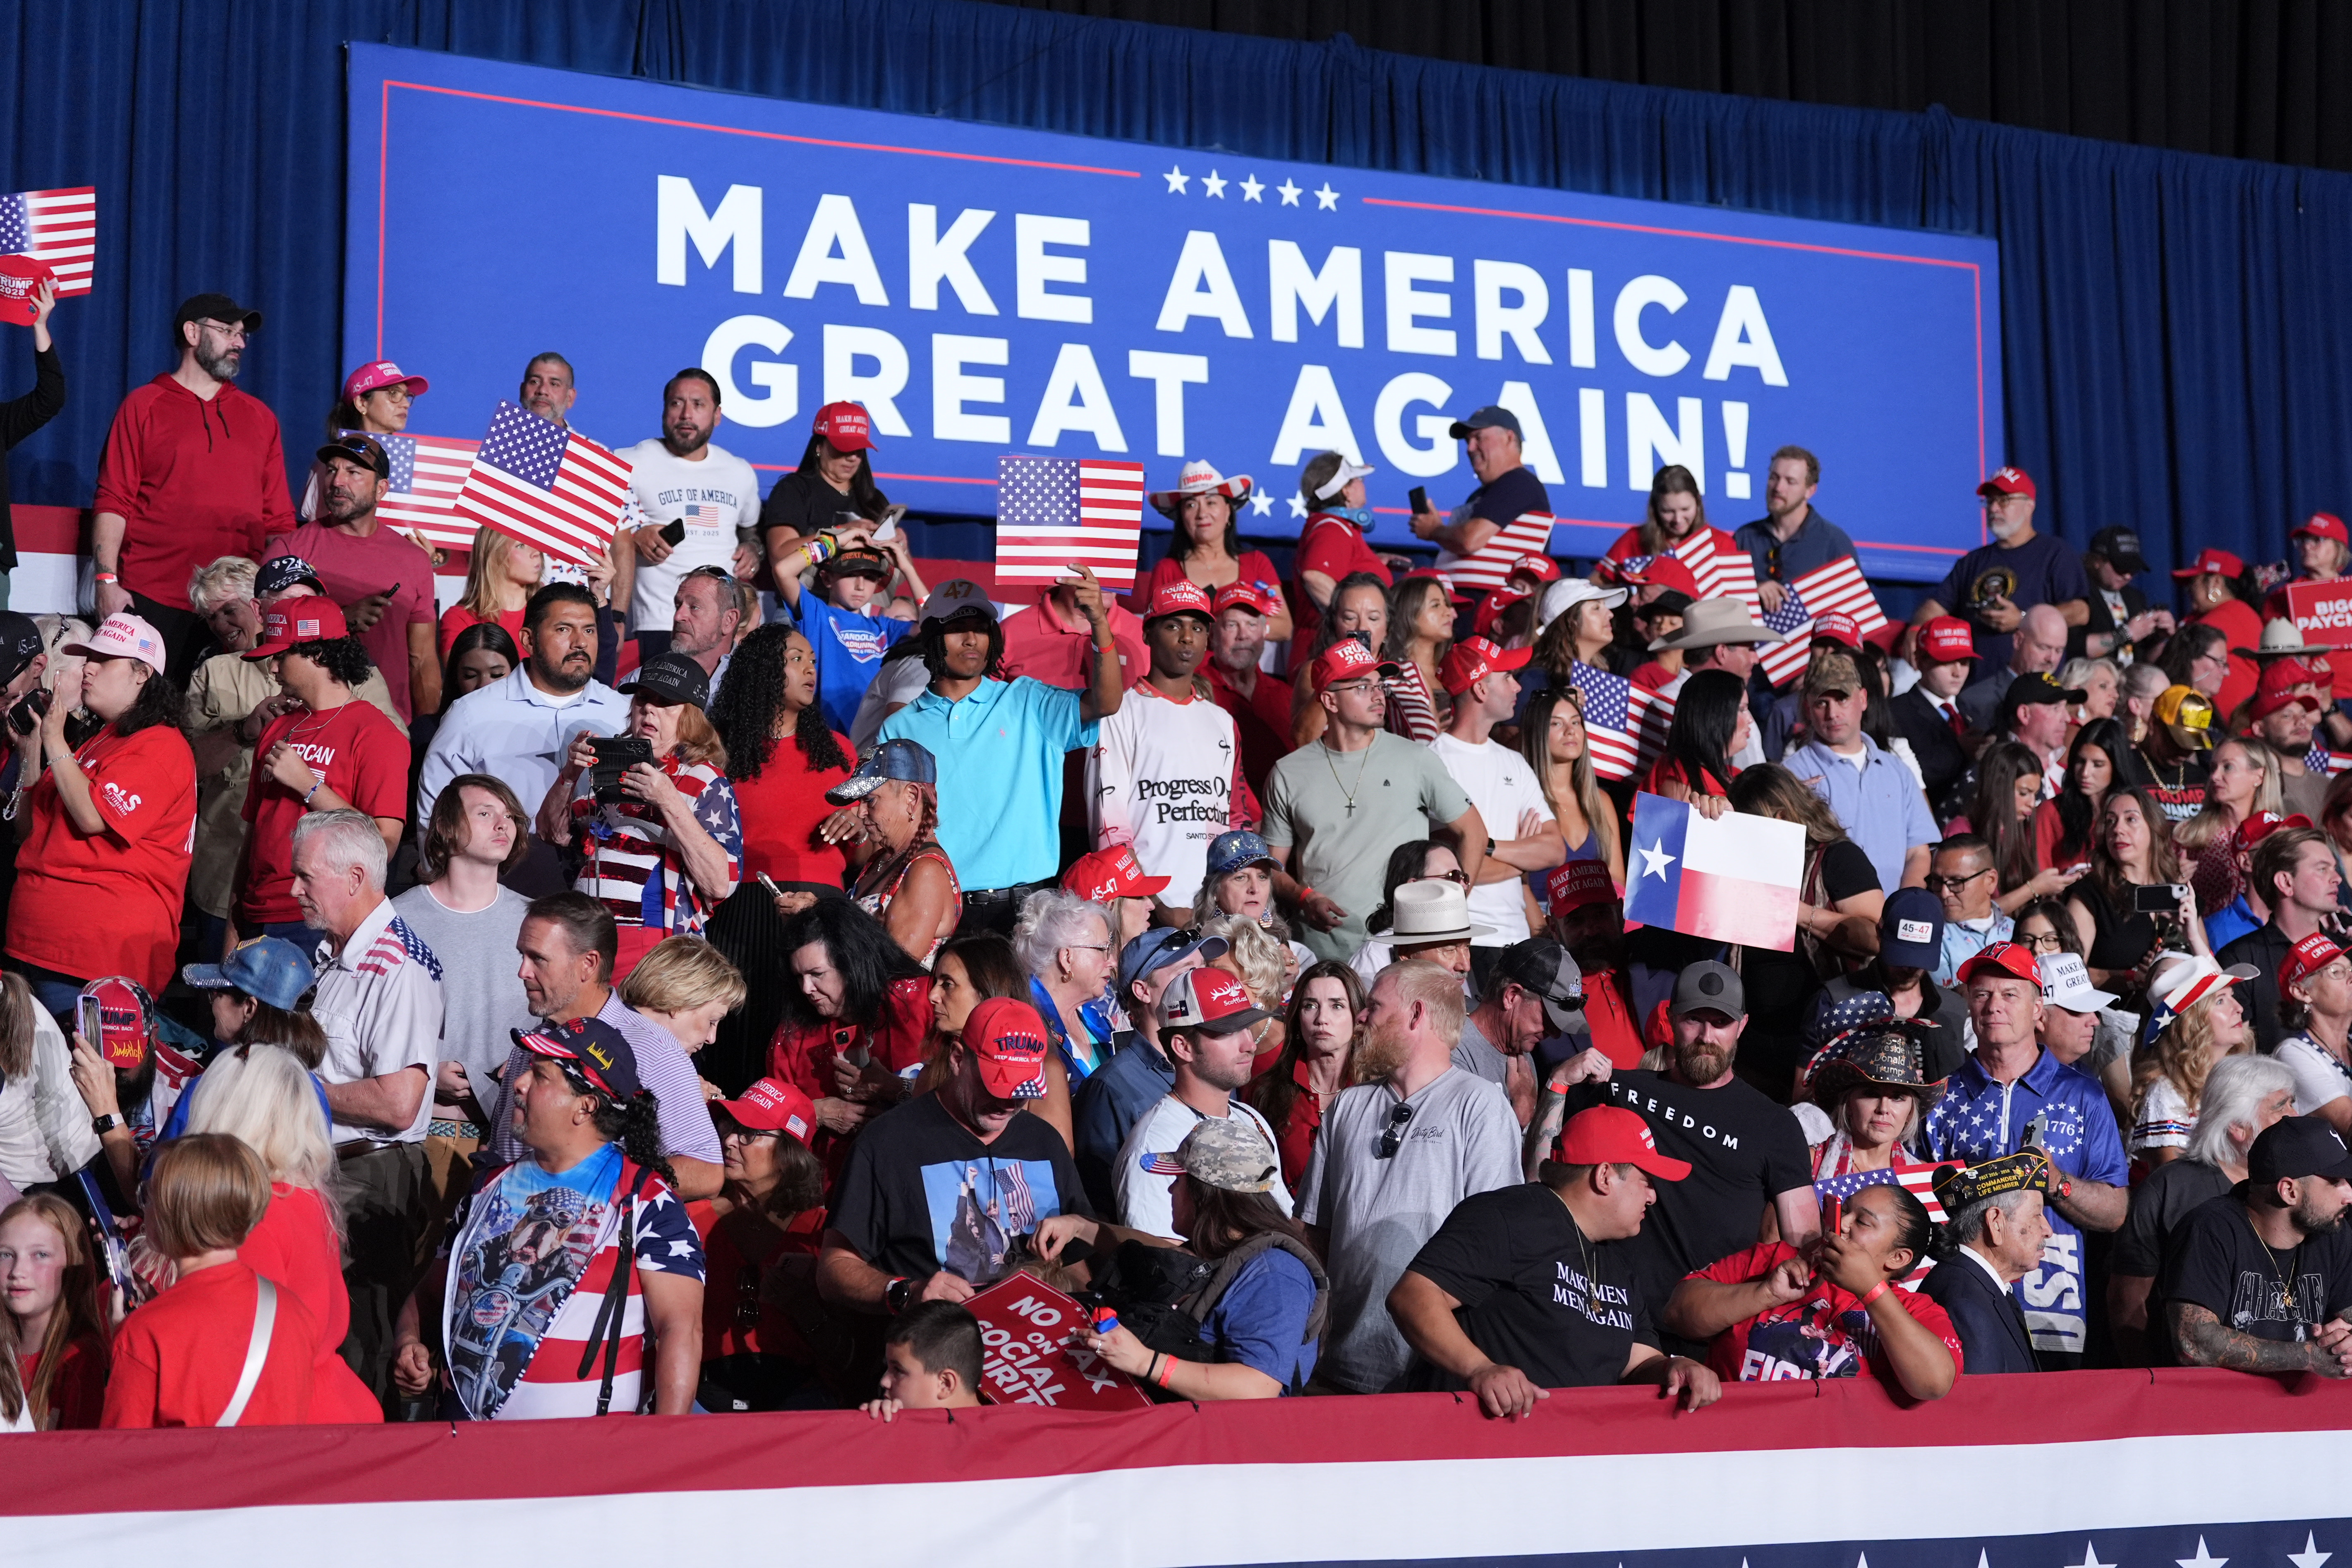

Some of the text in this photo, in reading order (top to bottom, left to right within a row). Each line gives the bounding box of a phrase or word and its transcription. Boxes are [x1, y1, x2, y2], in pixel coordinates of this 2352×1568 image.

[0, 277, 34, 290] RUMP
[657, 175, 1789, 387] MAKE AMERICA
[353, 376, 373, 393] 45-47
[701, 315, 1751, 499] GREAT AGAIN!
[836, 415, 853, 424] MAKE
[839, 425, 856, 433] GREAT
[1183, 473, 1213, 486] TRUMP
[658, 489, 737, 509] GULF OF AMERICA
[944, 581, 973, 600] 47
[1162, 584, 1205, 599] FOUR MORE
[1171, 592, 1200, 602] YEARS!
[2315, 599, 2352, 616] BIG
[102, 630, 127, 643] AGAIN
[103, 619, 135, 637] AMERICA
[266, 626, 283, 637] GAIN
[657, 661, 688, 679] AMERICA
[1470, 663, 1488, 680] 45-47
[657, 674, 680, 688] AGAIN
[1138, 779, 1212, 800] Progress
[2147, 789, 2206, 804] TRUMP
[1550, 865, 1606, 889] MAKE AMERICA
[1091, 878, 1118, 900] 45-47
[1557, 878, 1605, 899] GREAT AGAIN
[1902, 923, 1929, 934] 45-47
[1984, 941, 2012, 960] 47
[2056, 963, 2079, 977] MAKE
[110, 1039, 144, 1063] AMERICA
[993, 1035, 1044, 1054] TRUMP
[1874, 1053, 1905, 1066] Donald
[1874, 1063, 1904, 1077] Trump
[753, 1080, 786, 1103] AMERICA
[750, 1092, 774, 1110] AGAIN
[1611, 1082, 1738, 1150] FREEDOM
[1411, 1126, 1445, 1139] Dirty Bird
[2044, 1119, 2075, 1136] 1776
[1976, 1175, 2017, 1190] COMMANDER
[1978, 1181, 2019, 1197] LIFE MEMBER
[1594, 1284, 1628, 1306] MEN
[1007, 1295, 1062, 1326] NO
[1552, 1283, 1632, 1332] MEN AGAIN
[1027, 1332, 1058, 1355] ON
[977, 1320, 1066, 1406] SOCIAL
